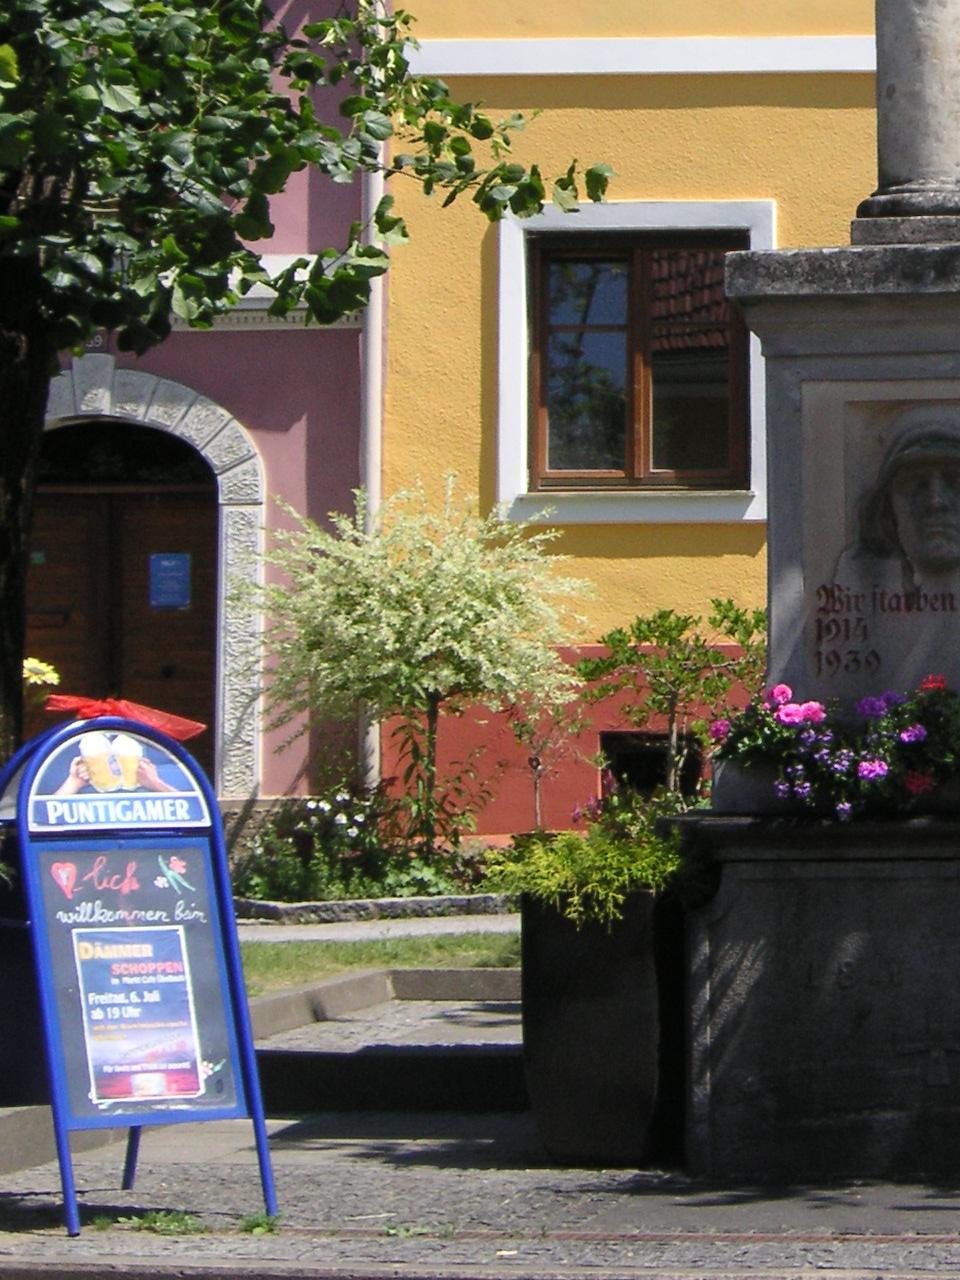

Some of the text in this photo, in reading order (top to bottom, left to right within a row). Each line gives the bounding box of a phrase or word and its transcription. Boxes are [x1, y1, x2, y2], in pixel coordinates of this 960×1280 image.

[816, 583, 865, 615] Wir
[815, 617, 868, 642] 1914
[815, 649, 881, 678] 1939
[46, 799, 191, 824] PUNTIGAMER
[56, 900, 170, 924] willkommen
[111, 961, 184, 975] SCHOPPEN
[106, 1007, 120, 1019] 19
